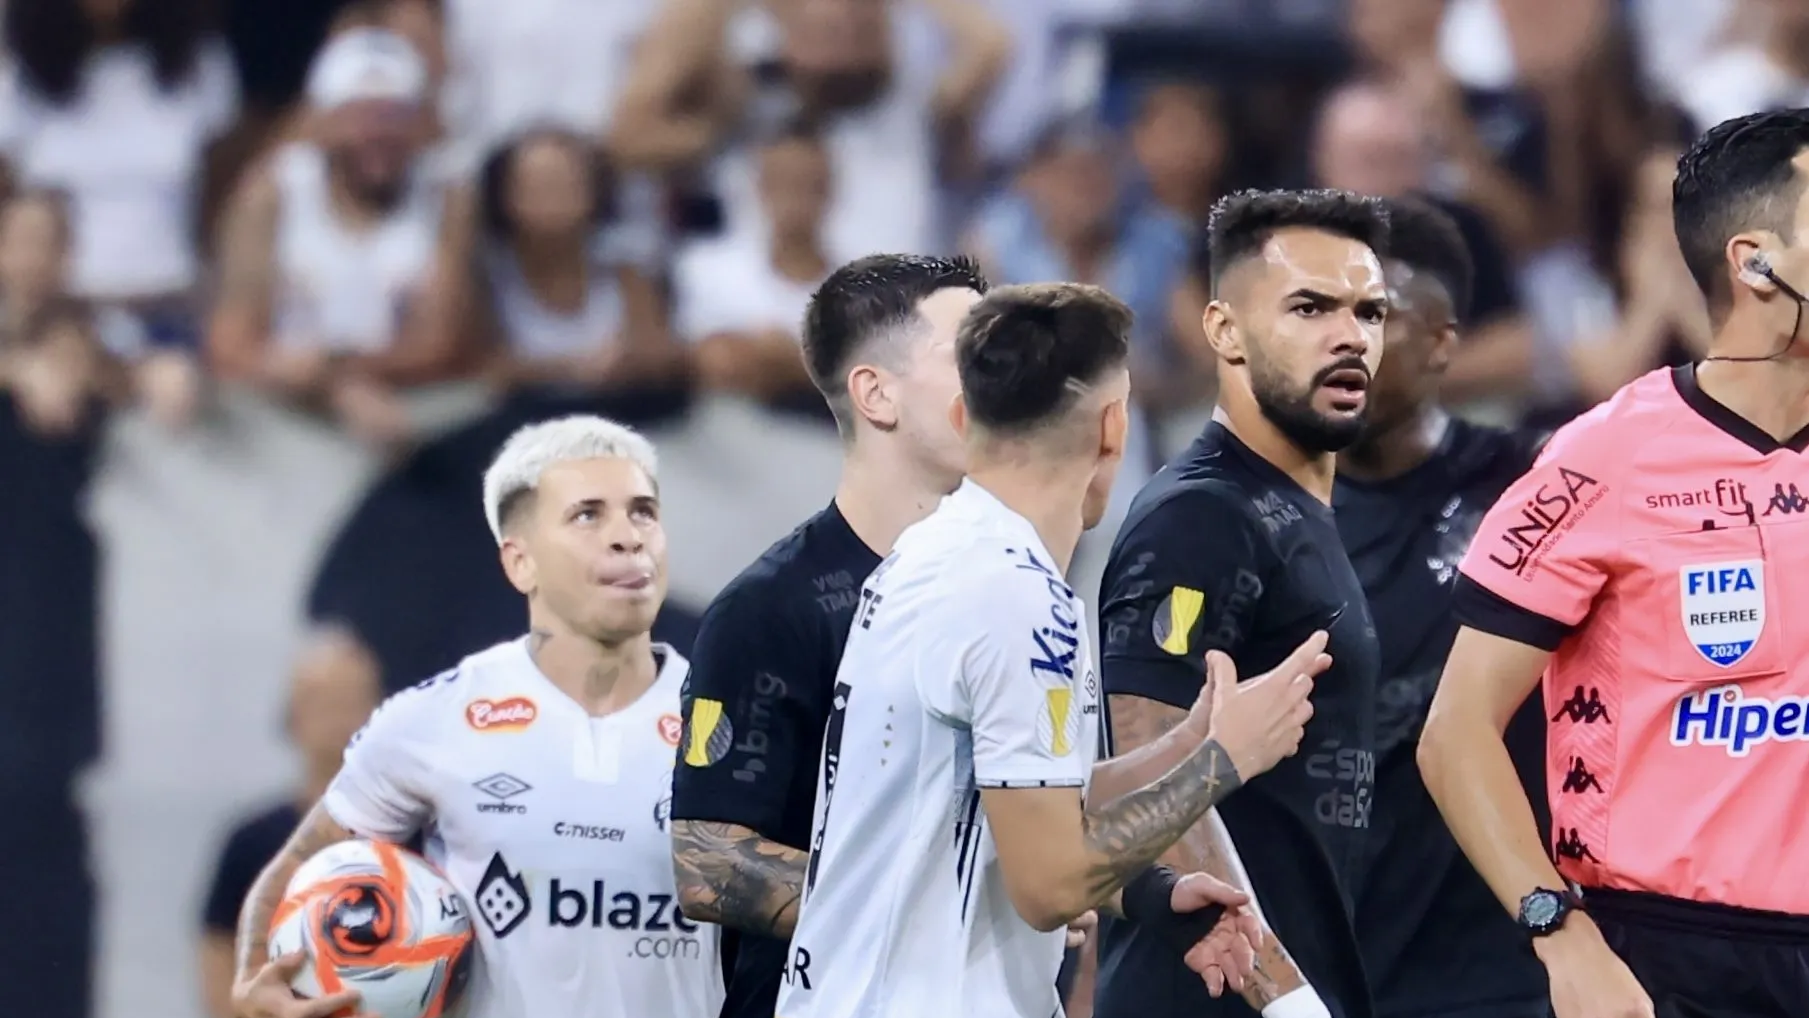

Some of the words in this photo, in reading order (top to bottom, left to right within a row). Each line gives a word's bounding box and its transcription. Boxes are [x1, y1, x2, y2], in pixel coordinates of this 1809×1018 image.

[1646, 488, 1712, 509] smart
[1714, 478, 1747, 508] fit
[1688, 567, 1757, 597] FIFA
[1689, 608, 1758, 626] REFEREE
[1710, 644, 1743, 660] 2024
[475, 802, 527, 815] umbro
[628, 936, 700, 960] .com
